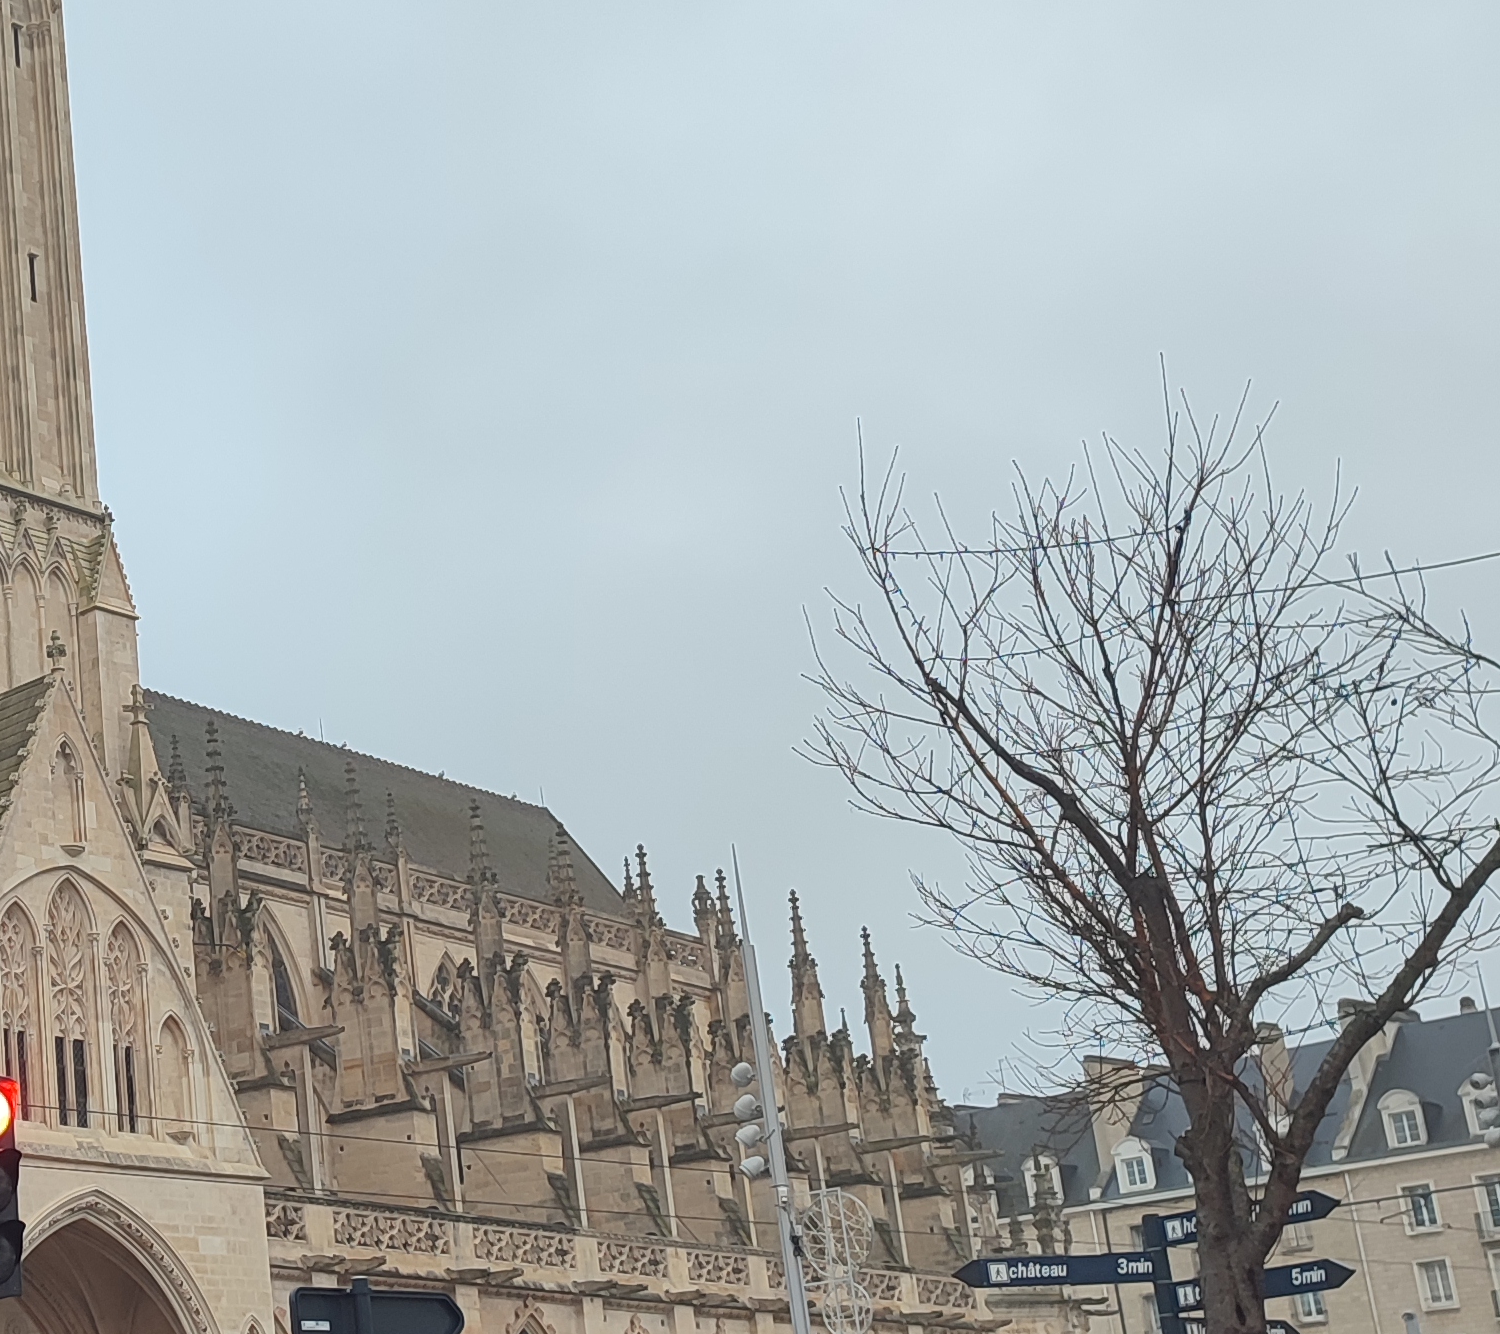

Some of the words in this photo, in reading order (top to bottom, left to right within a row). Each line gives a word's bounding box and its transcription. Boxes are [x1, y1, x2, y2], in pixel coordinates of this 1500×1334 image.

[1009, 1262, 1067, 1278] château
[1117, 1257, 1153, 1275] 3min
[1291, 1266, 1326, 1286] 5min
